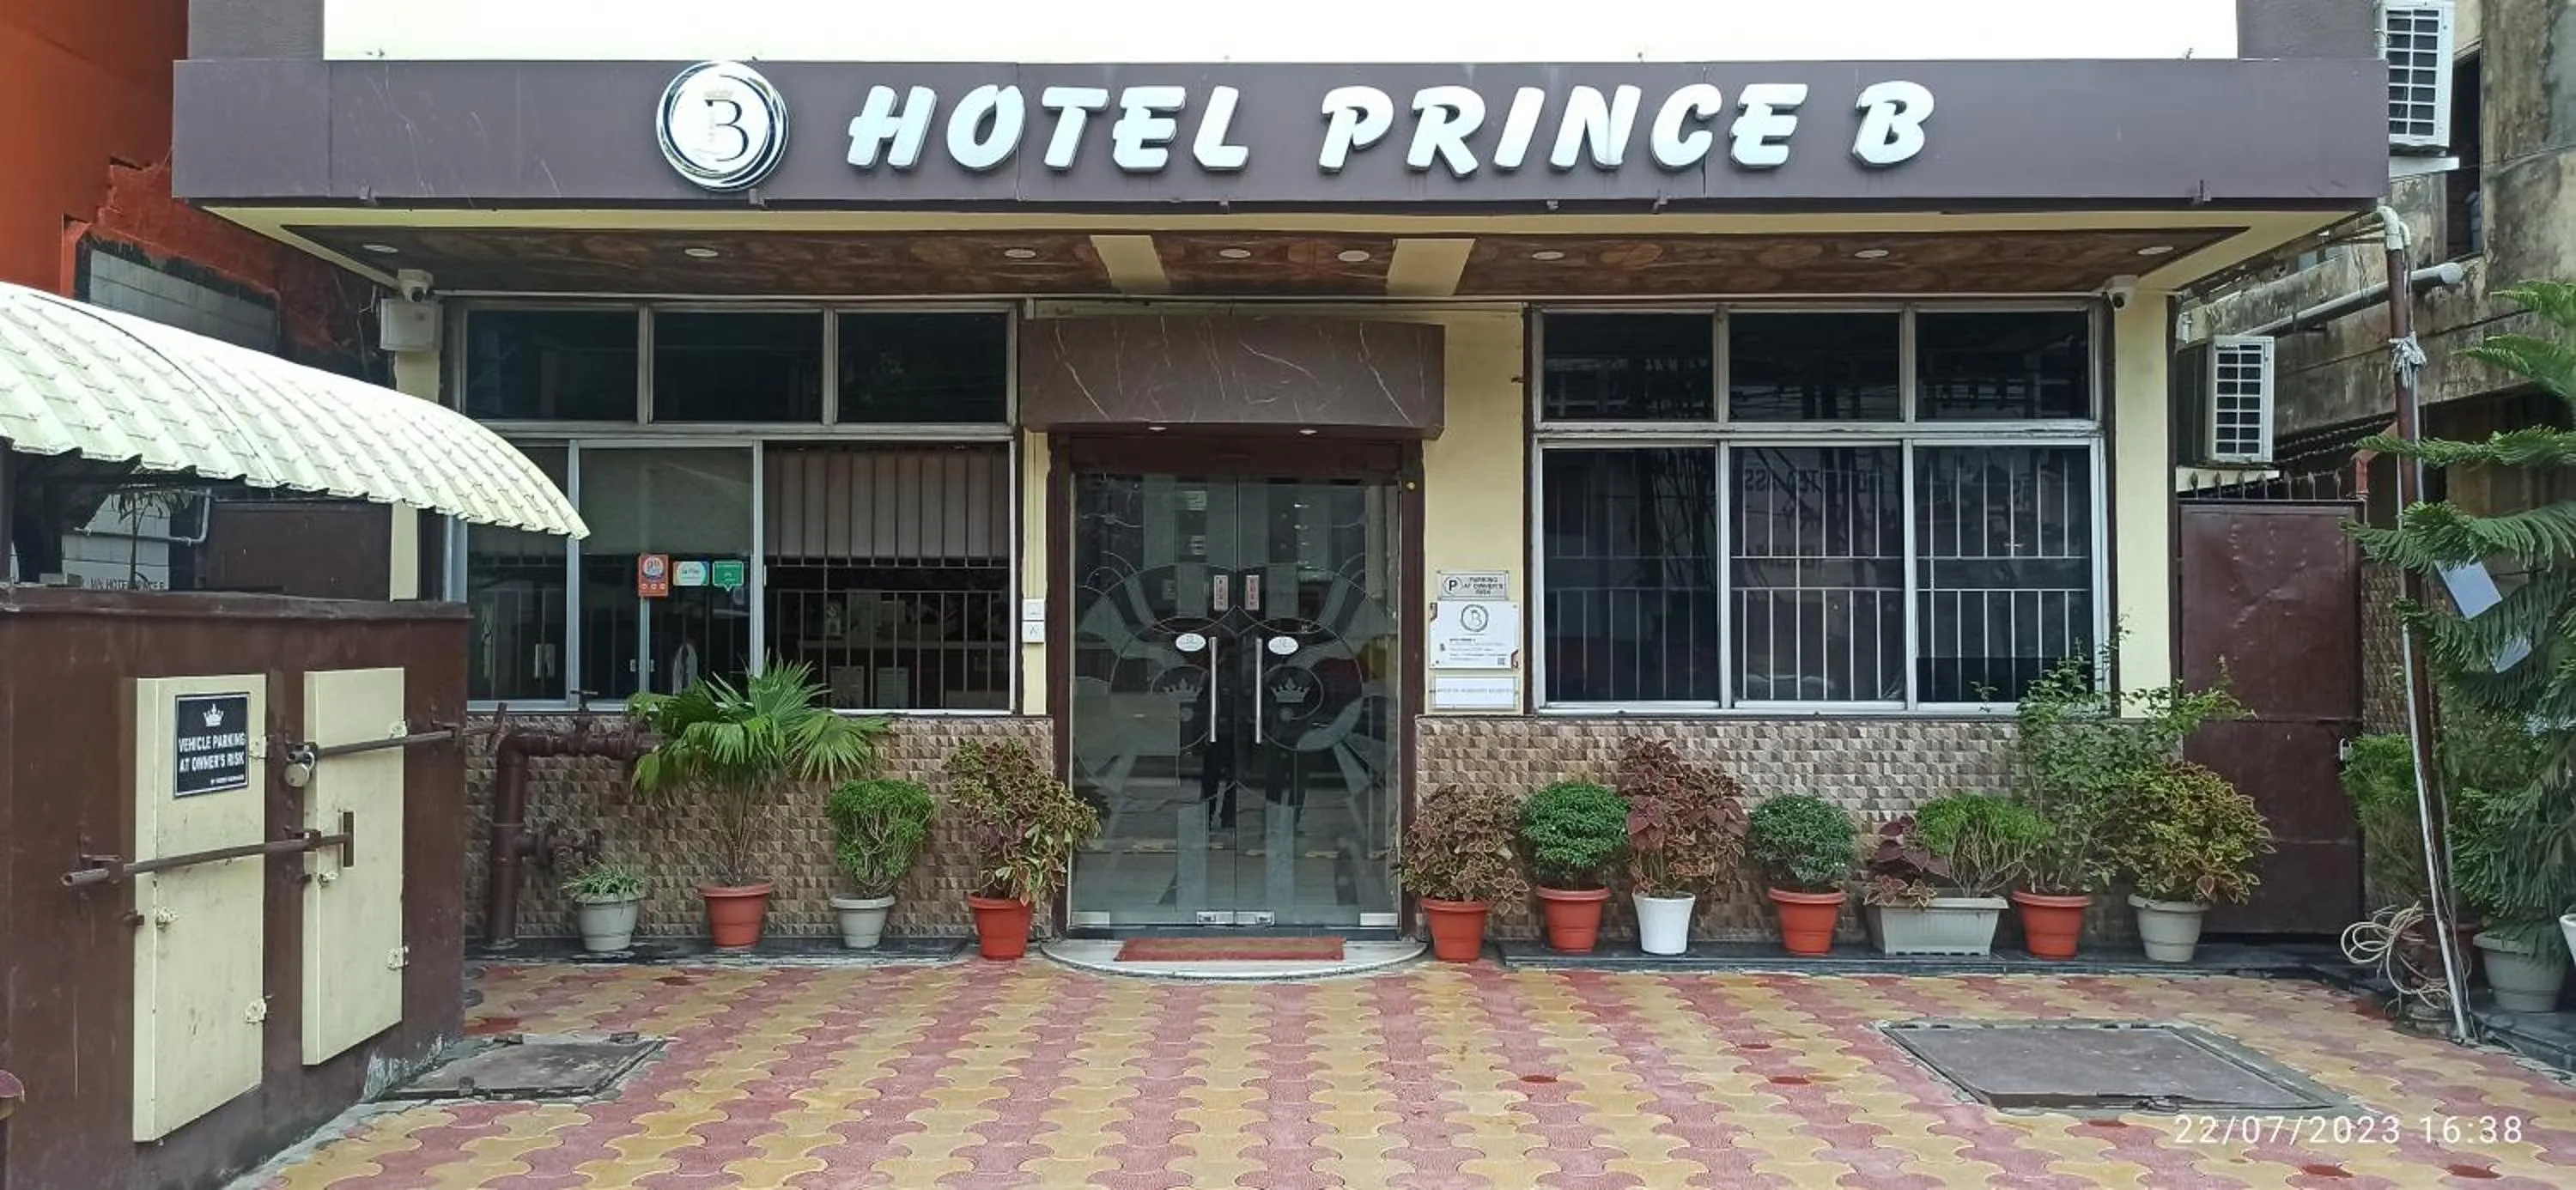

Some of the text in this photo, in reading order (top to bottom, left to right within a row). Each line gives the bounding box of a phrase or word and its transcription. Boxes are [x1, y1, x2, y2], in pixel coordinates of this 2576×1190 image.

[847, 81, 1935, 177] HOTEL PRINCE B
[1449, 580, 1458, 591] P
[178, 732, 246, 752] VEHICLE PARKING
[179, 751, 245, 773] AT OWNER'S RISK
